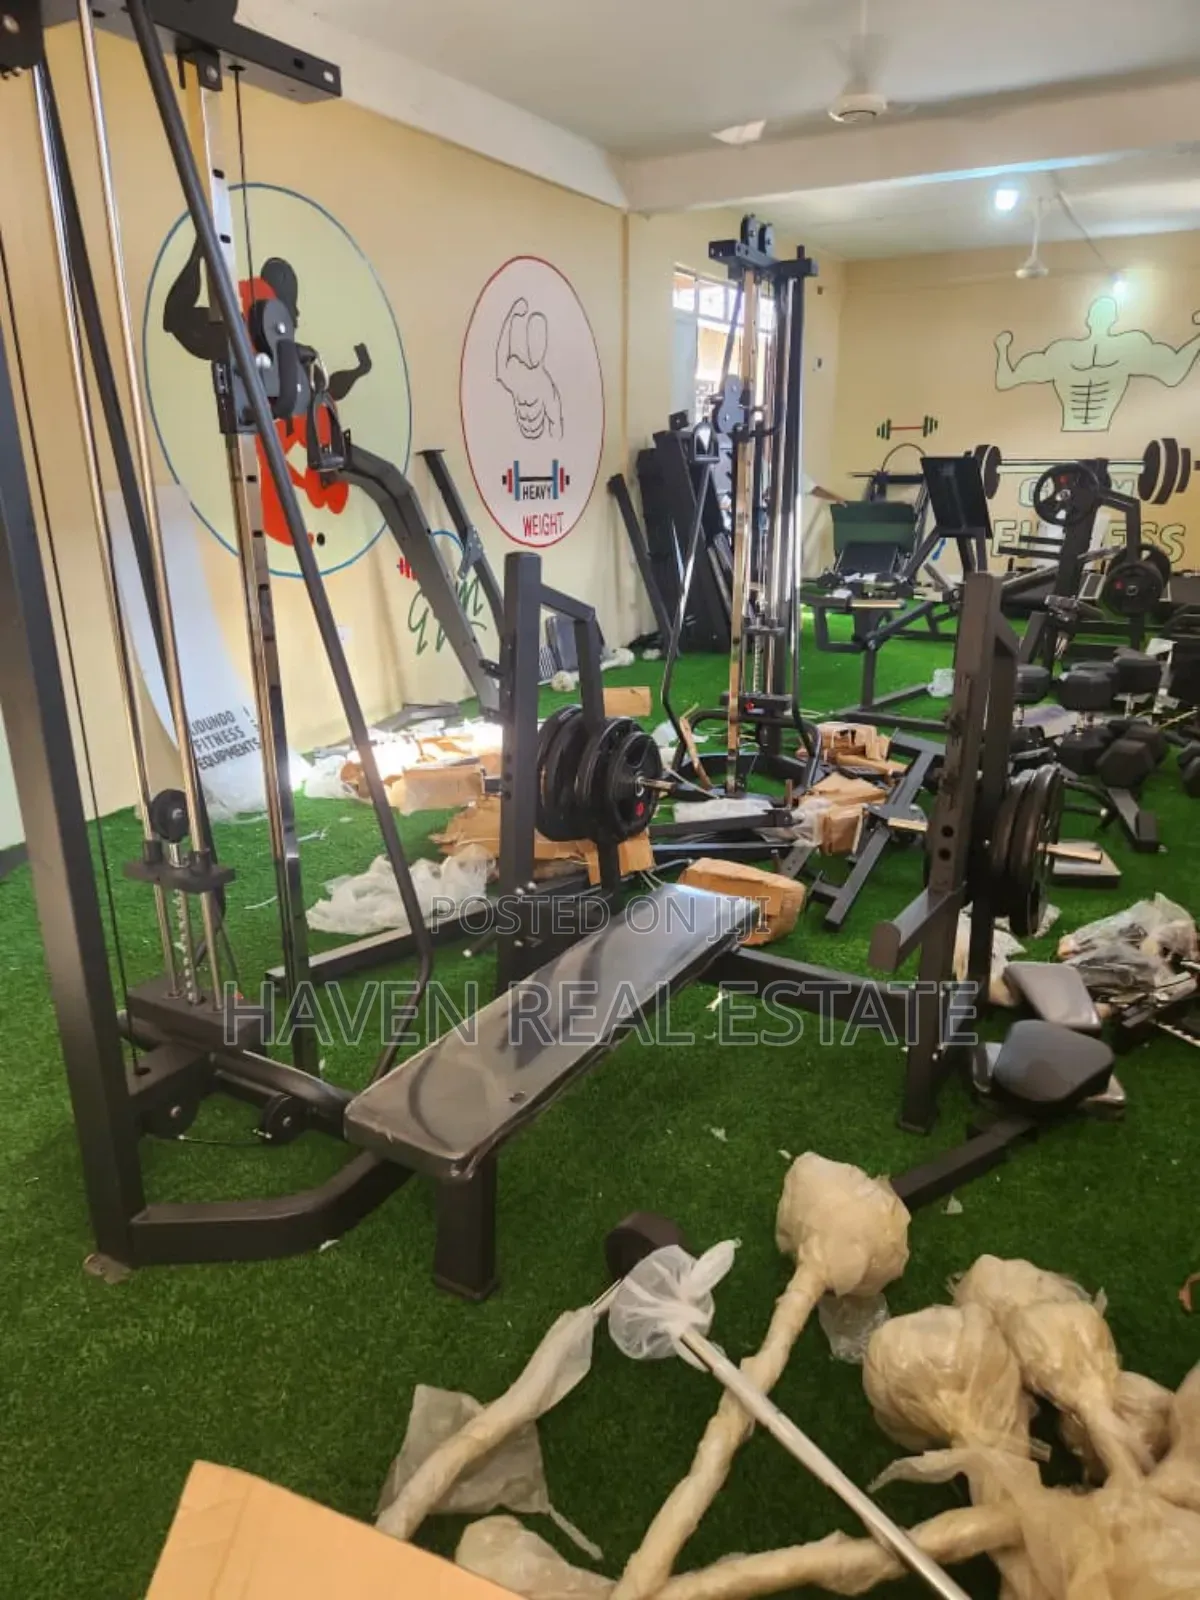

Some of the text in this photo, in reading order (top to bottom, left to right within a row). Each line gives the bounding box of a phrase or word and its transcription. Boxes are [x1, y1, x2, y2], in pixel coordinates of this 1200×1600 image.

[522, 484, 553, 500] HEAVY
[522, 511, 565, 537] WEIGHT
[192, 725, 246, 753] FITNESS
